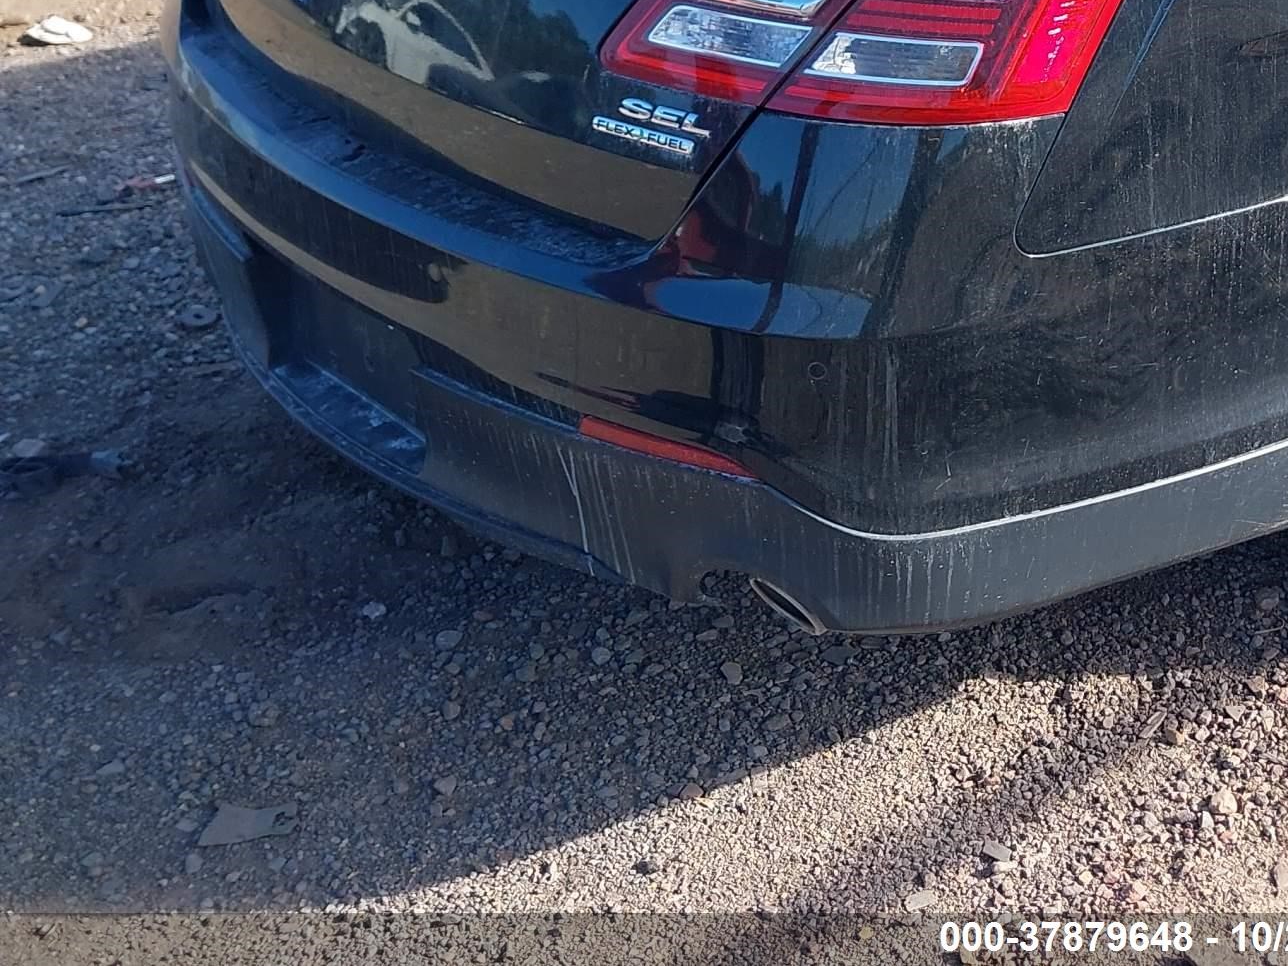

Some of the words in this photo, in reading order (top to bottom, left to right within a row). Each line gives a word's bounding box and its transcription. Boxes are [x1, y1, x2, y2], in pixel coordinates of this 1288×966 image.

[595, 118, 635, 137] FLEX
[646, 132, 688, 152] FUEL
[618, 97, 711, 138] SEL
